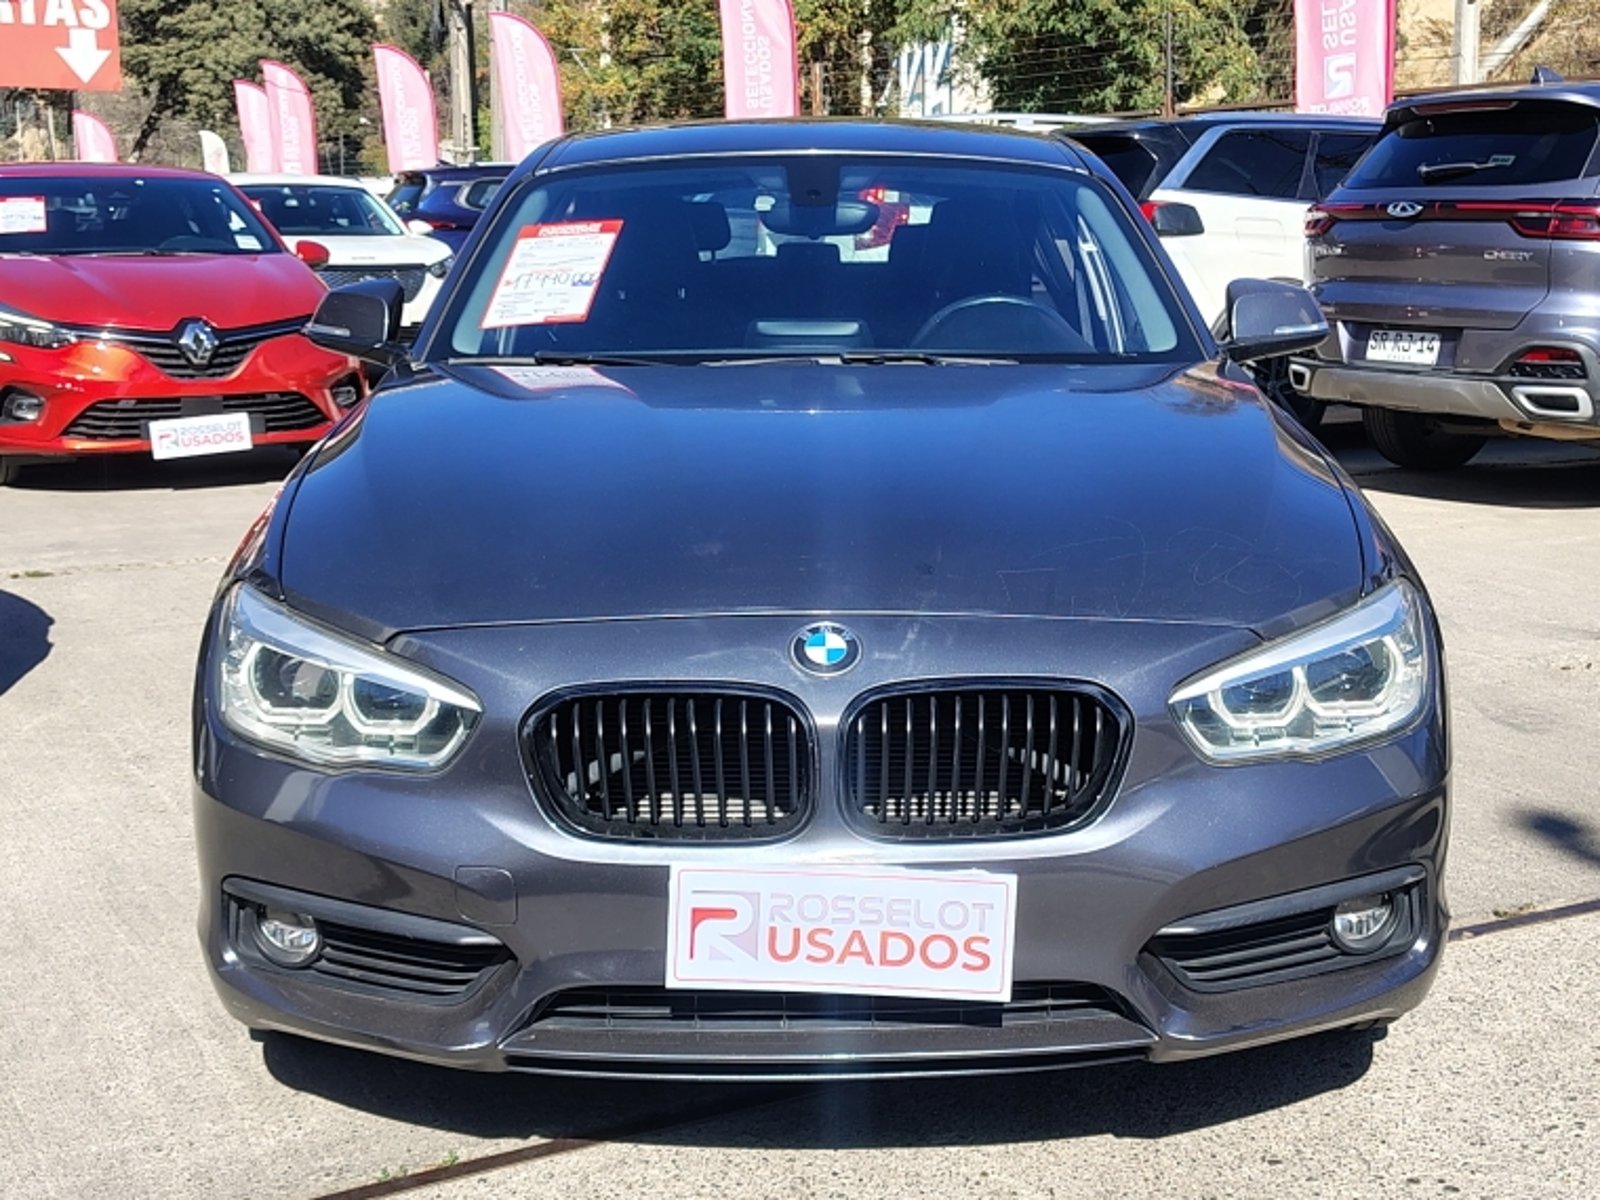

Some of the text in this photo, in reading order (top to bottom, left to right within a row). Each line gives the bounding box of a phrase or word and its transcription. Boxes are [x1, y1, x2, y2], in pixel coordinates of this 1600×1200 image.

[181, 431, 245, 448] USADOS
[768, 893, 995, 932] ROSSELOT
[767, 926, 991, 972] USADOS
